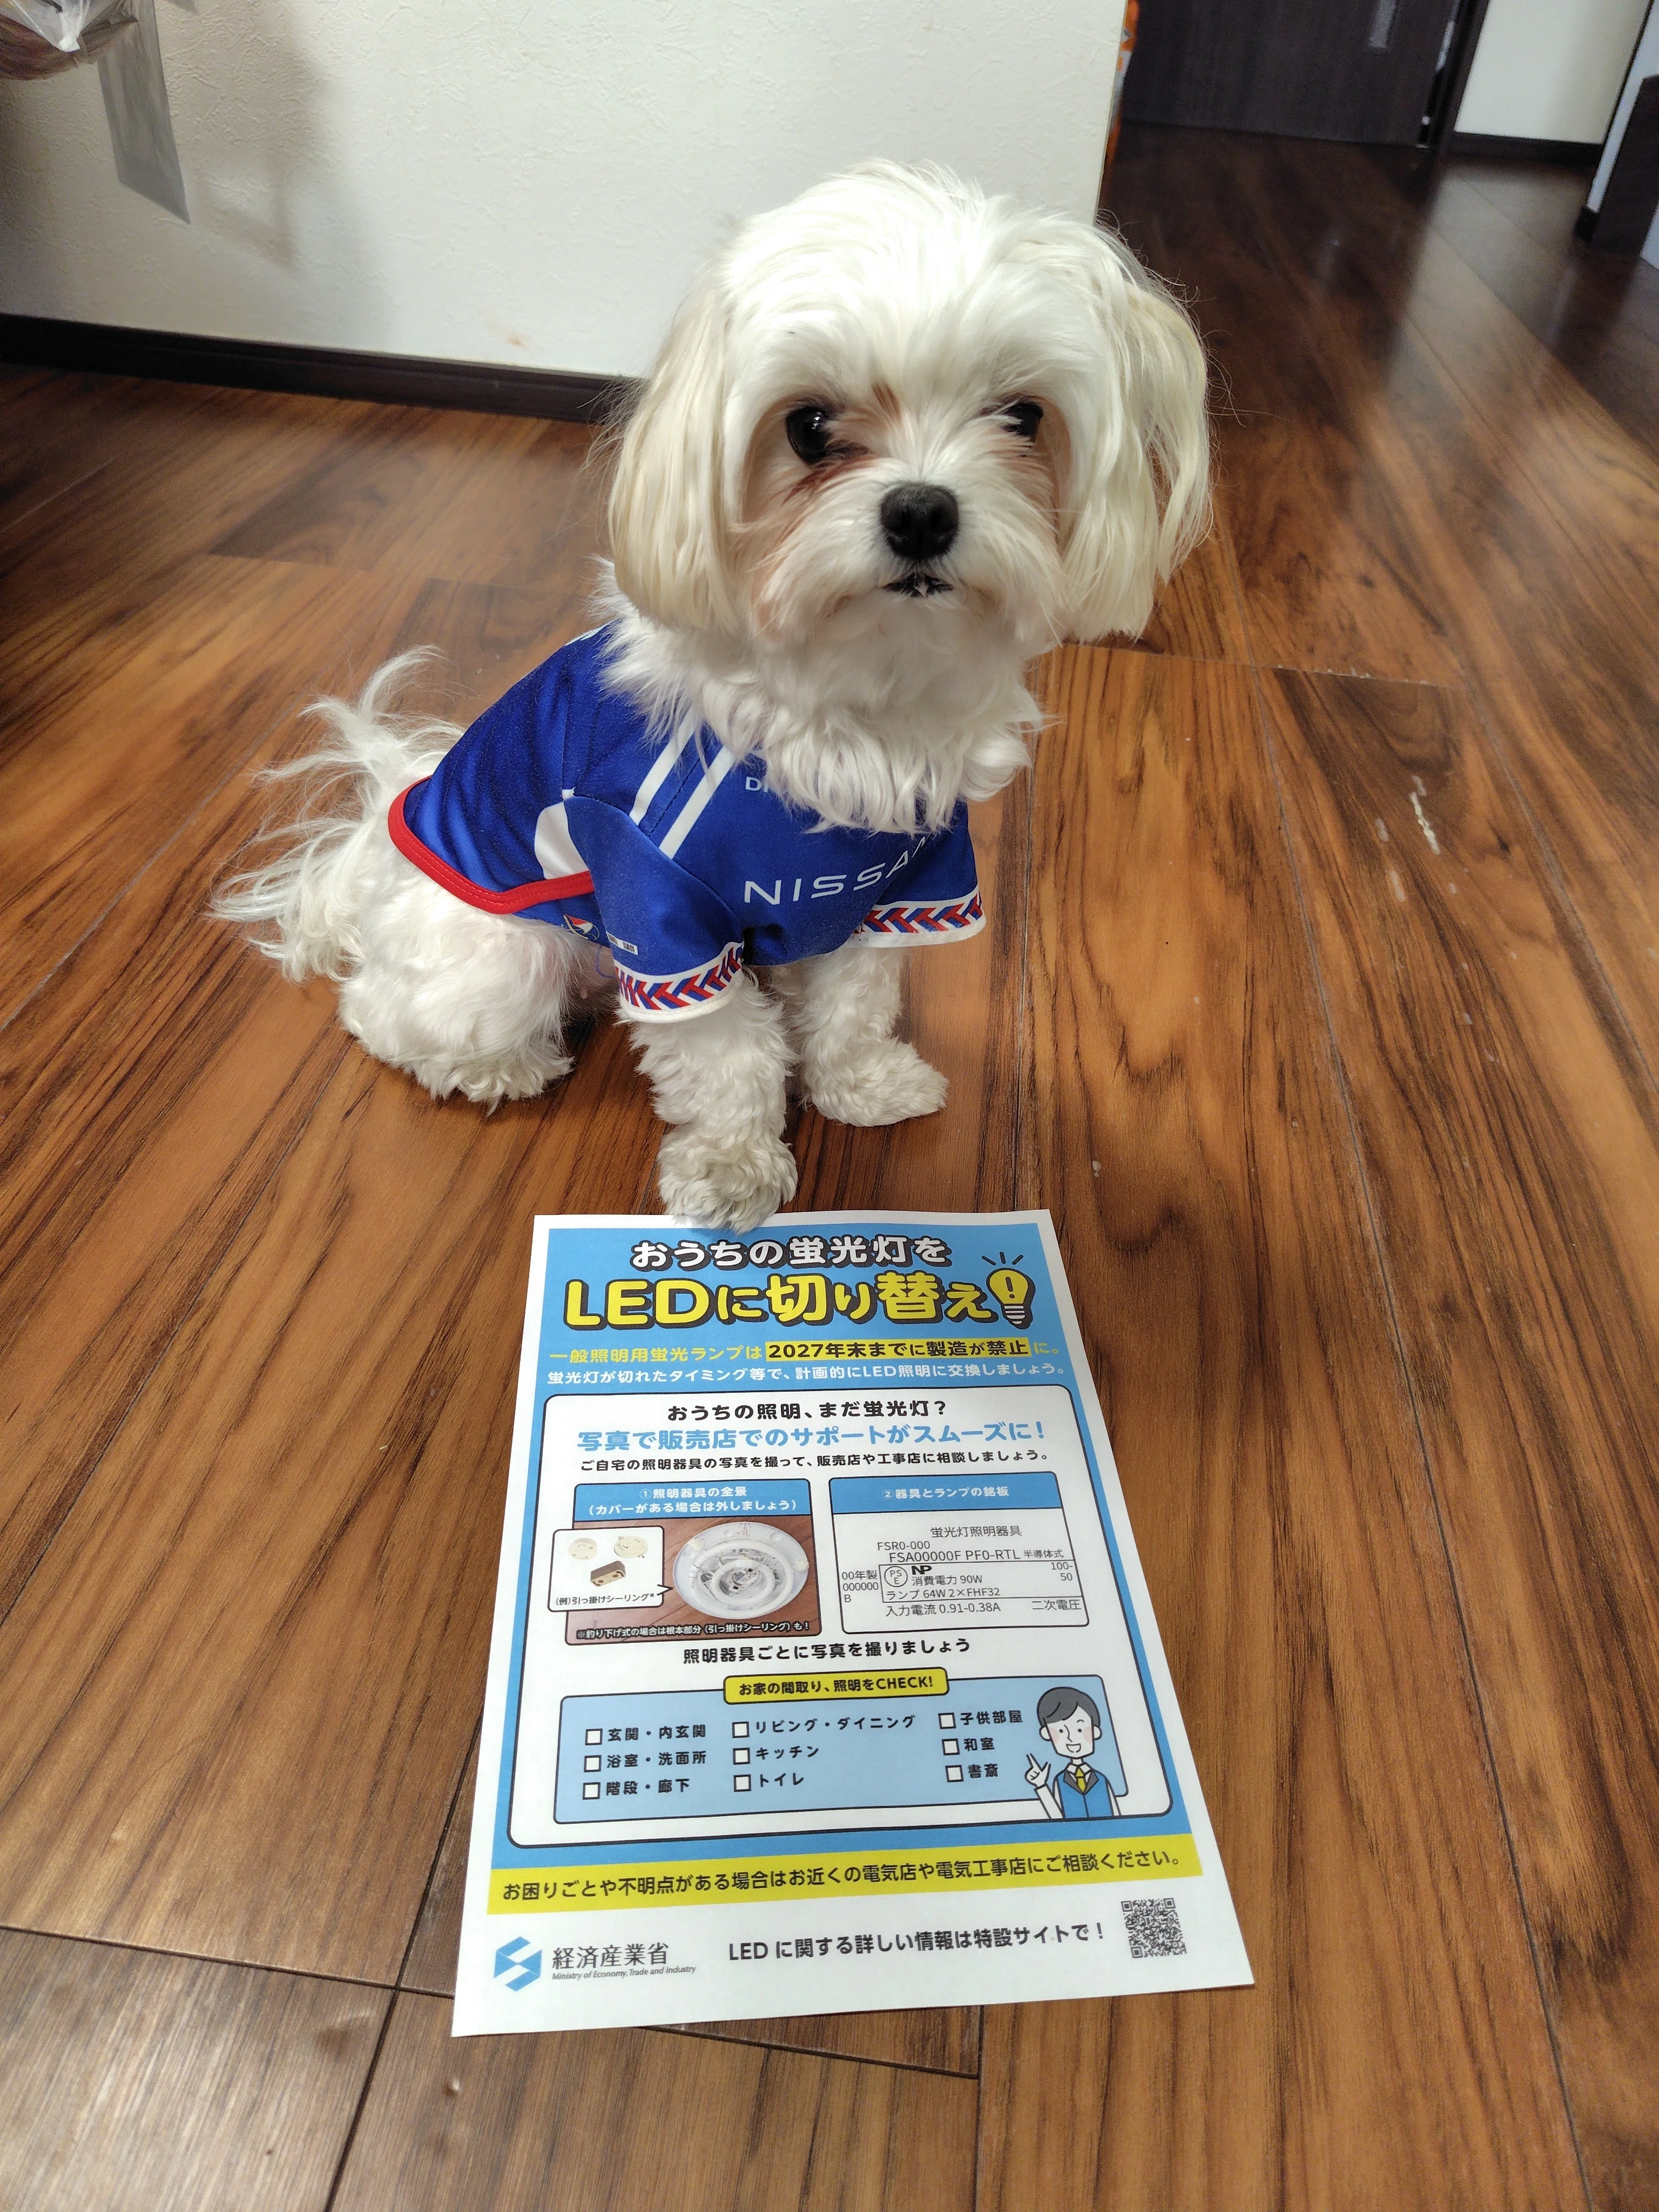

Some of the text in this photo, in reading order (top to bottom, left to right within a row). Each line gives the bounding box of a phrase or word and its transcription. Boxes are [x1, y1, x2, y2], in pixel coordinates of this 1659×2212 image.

[631, 1235, 950, 1271] おうちの蛍光灯を
[930, 1526, 1022, 1539] 蛍光灯照明器具
[1023, 1549, 1064, 1559] 半導体式
[912, 1574, 982, 1587] 消費電力 90W
[1060, 1573, 1073, 1581] 50
[844, 1594, 852, 1602] B
[886, 1589, 920, 1600] ランプ
[923, 1588, 946, 1599] 64W
[886, 1604, 936, 1617] 入力電流
[1031, 1599, 1082, 1611] 二次電圧
[683, 1638, 970, 1664] 照明器具ごとに写真を撮りましょう
[756, 1715, 916, 1734] リビング・ダイニング
[960, 1710, 1023, 1726] 子供部屋
[607, 1724, 706, 1742] 玄関・内玄関
[756, 1745, 820, 1759] キッチン
[963, 1737, 995, 1752] 和室
[606, 1750, 707, 1769] 浴室・洗面所
[967, 1763, 999, 1779] 書斎
[605, 1778, 690, 1796] 階段・廊下
[759, 1773, 805, 1788] トイレ
[502, 1850, 1179, 1901] お困りごとや不明点がある場合はお近くの電気店や電気工事店にご相談ください。
[551, 1942, 669, 1970] 経済産業省
[552, 1972, 582, 1981] Ministry
[584, 1971, 592, 1979] of
[629, 1968, 648, 1976] Trade
[666, 1965, 697, 1974] Industry
